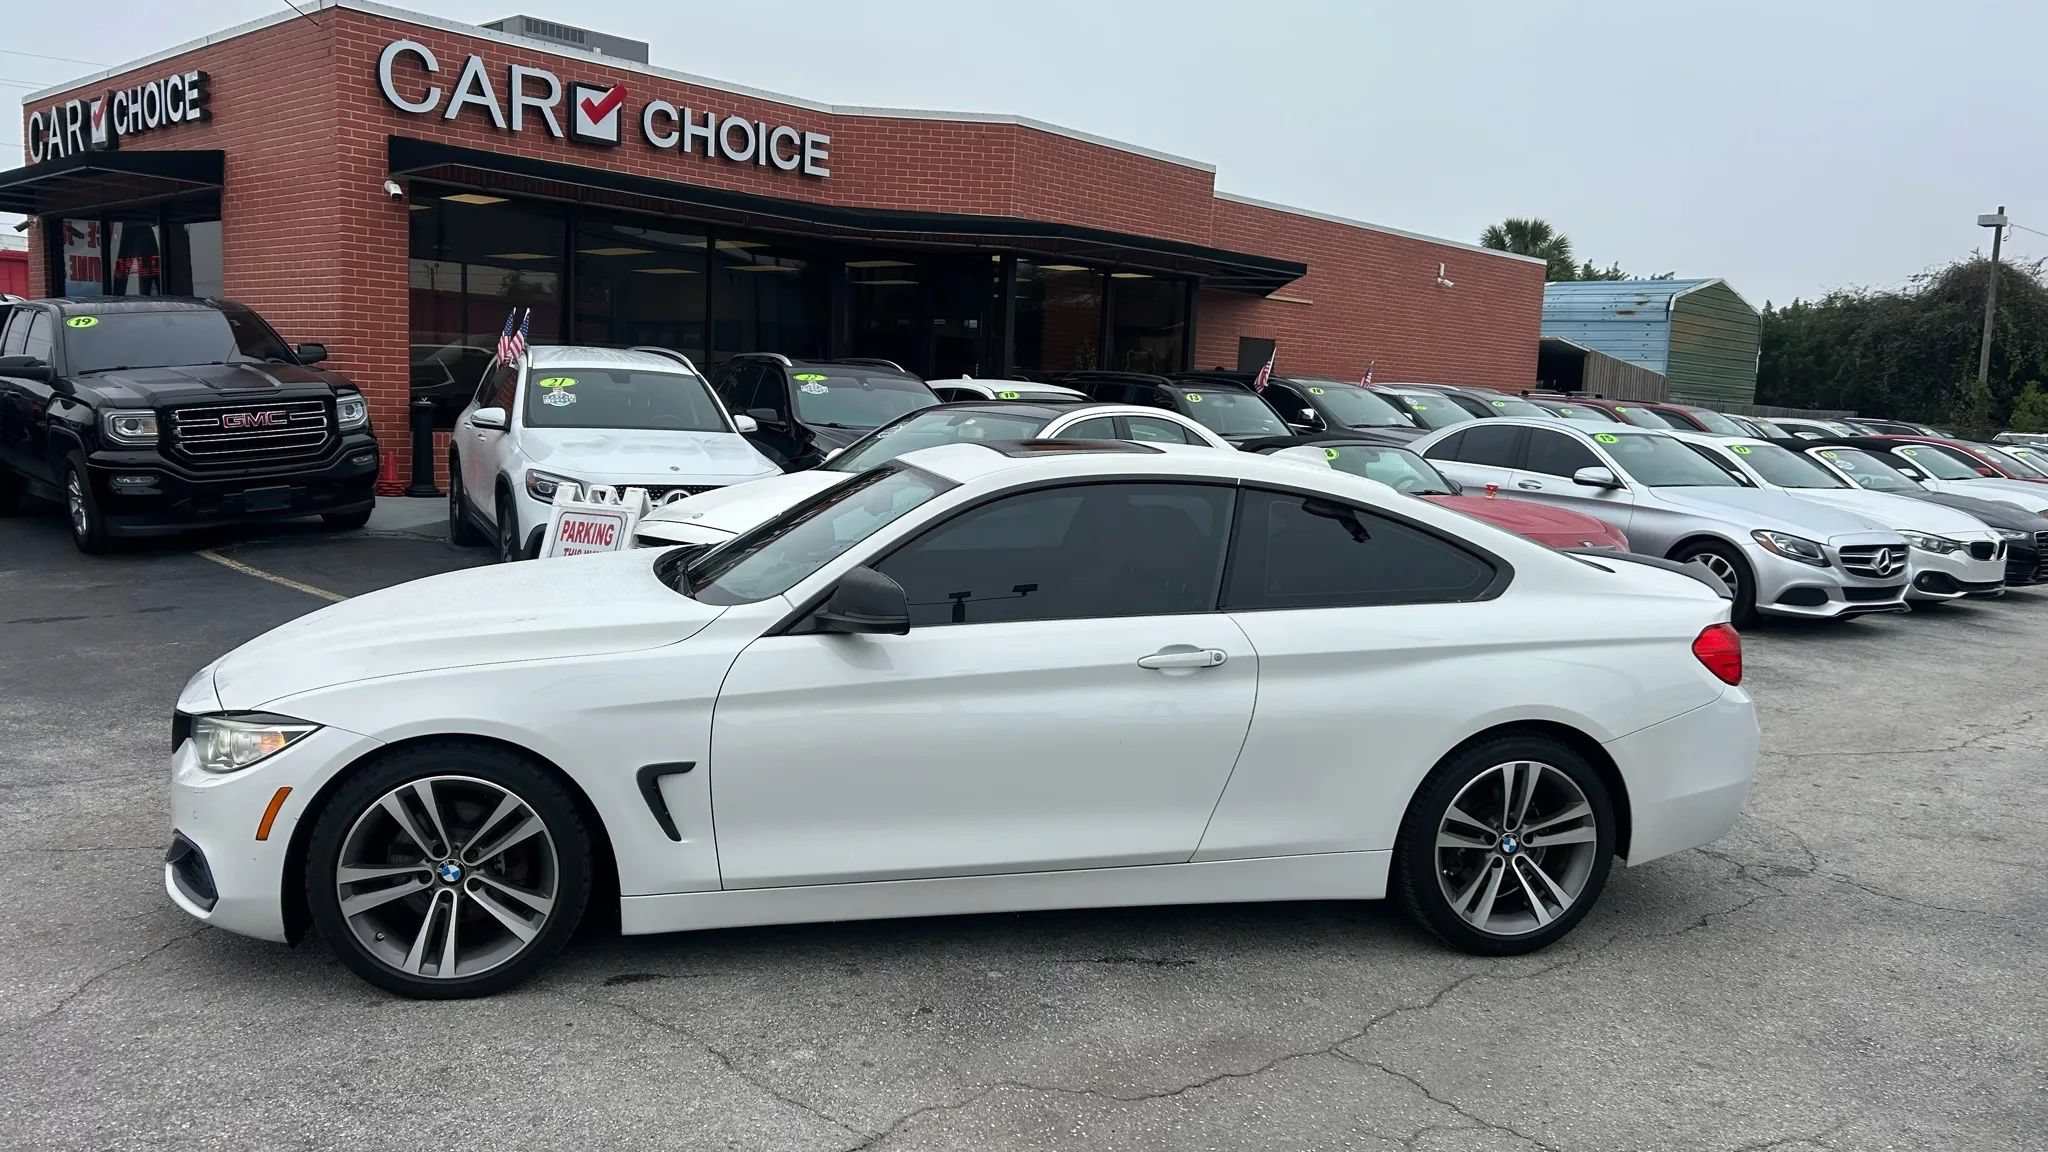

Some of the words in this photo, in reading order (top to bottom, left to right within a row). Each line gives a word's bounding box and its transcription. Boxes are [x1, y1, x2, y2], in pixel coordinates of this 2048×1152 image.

[28, 98, 85, 163] CAR
[113, 70, 201, 136] CHOICE
[378, 39, 565, 138] CAR
[643, 99, 830, 178] CHOICE
[74, 317, 92, 326] 19
[549, 378, 566, 387] 21
[222, 410, 288, 429] GMC
[560, 520, 615, 546] PARKING
